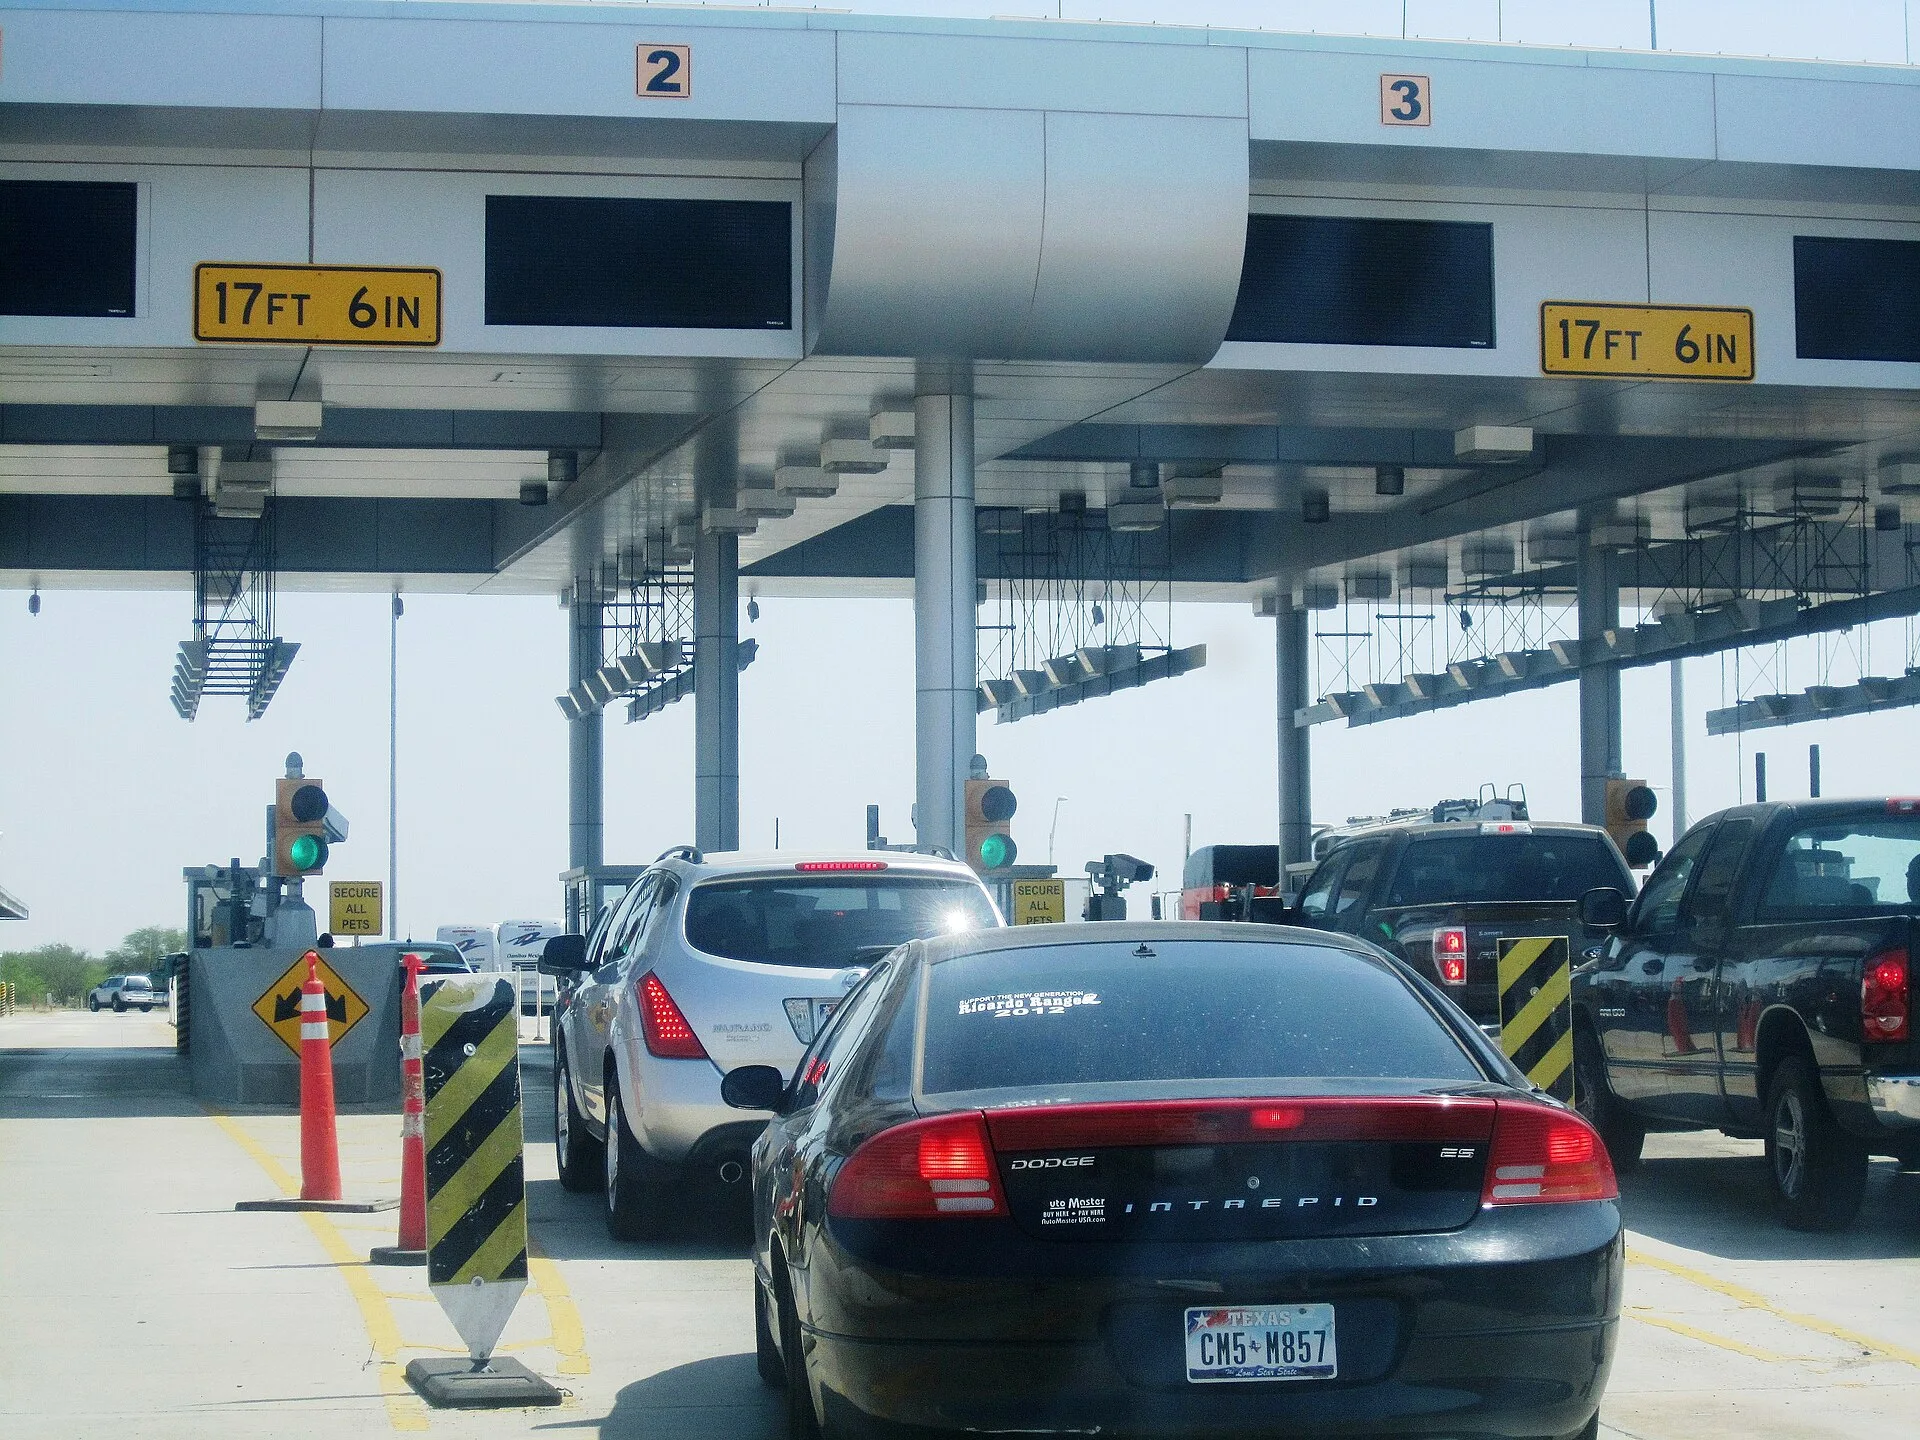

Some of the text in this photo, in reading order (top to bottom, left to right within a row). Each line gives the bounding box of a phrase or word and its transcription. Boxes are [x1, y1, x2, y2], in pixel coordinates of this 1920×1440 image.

[646, 50, 680, 92] 2
[1390, 80, 1421, 121] 3
[215, 281, 420, 329] 17FT 6IN
[1559, 319, 1736, 364] 17FT 6IN
[334, 888, 378, 898] SECURE
[1018, 885, 1060, 895] SECURE
[346, 904, 367, 914] ALL
[1030, 901, 1049, 910] ALL
[342, 919, 369, 929] PETS
[1026, 916, 1053, 925] PETS
[960, 995, 995, 1006] SUPPORT
[1033, 990, 1084, 998] GENERATION
[959, 998, 1024, 1014] Ricardo
[994, 1006, 1065, 1017] 2012
[1440, 1147, 1475, 1158] ES
[1011, 1156, 1095, 1169] DODGE
[1068, 1197, 1105, 1209] Master
[1125, 1197, 1378, 1213] INTREPID
[1228, 1311, 1292, 1327] TEXAS
[1200, 1330, 1326, 1365] CM5 M857
[1236, 1368, 1255, 1377] Lone
[1257, 1367, 1274, 1376] Star
[1277, 1367, 1297, 1376] State
